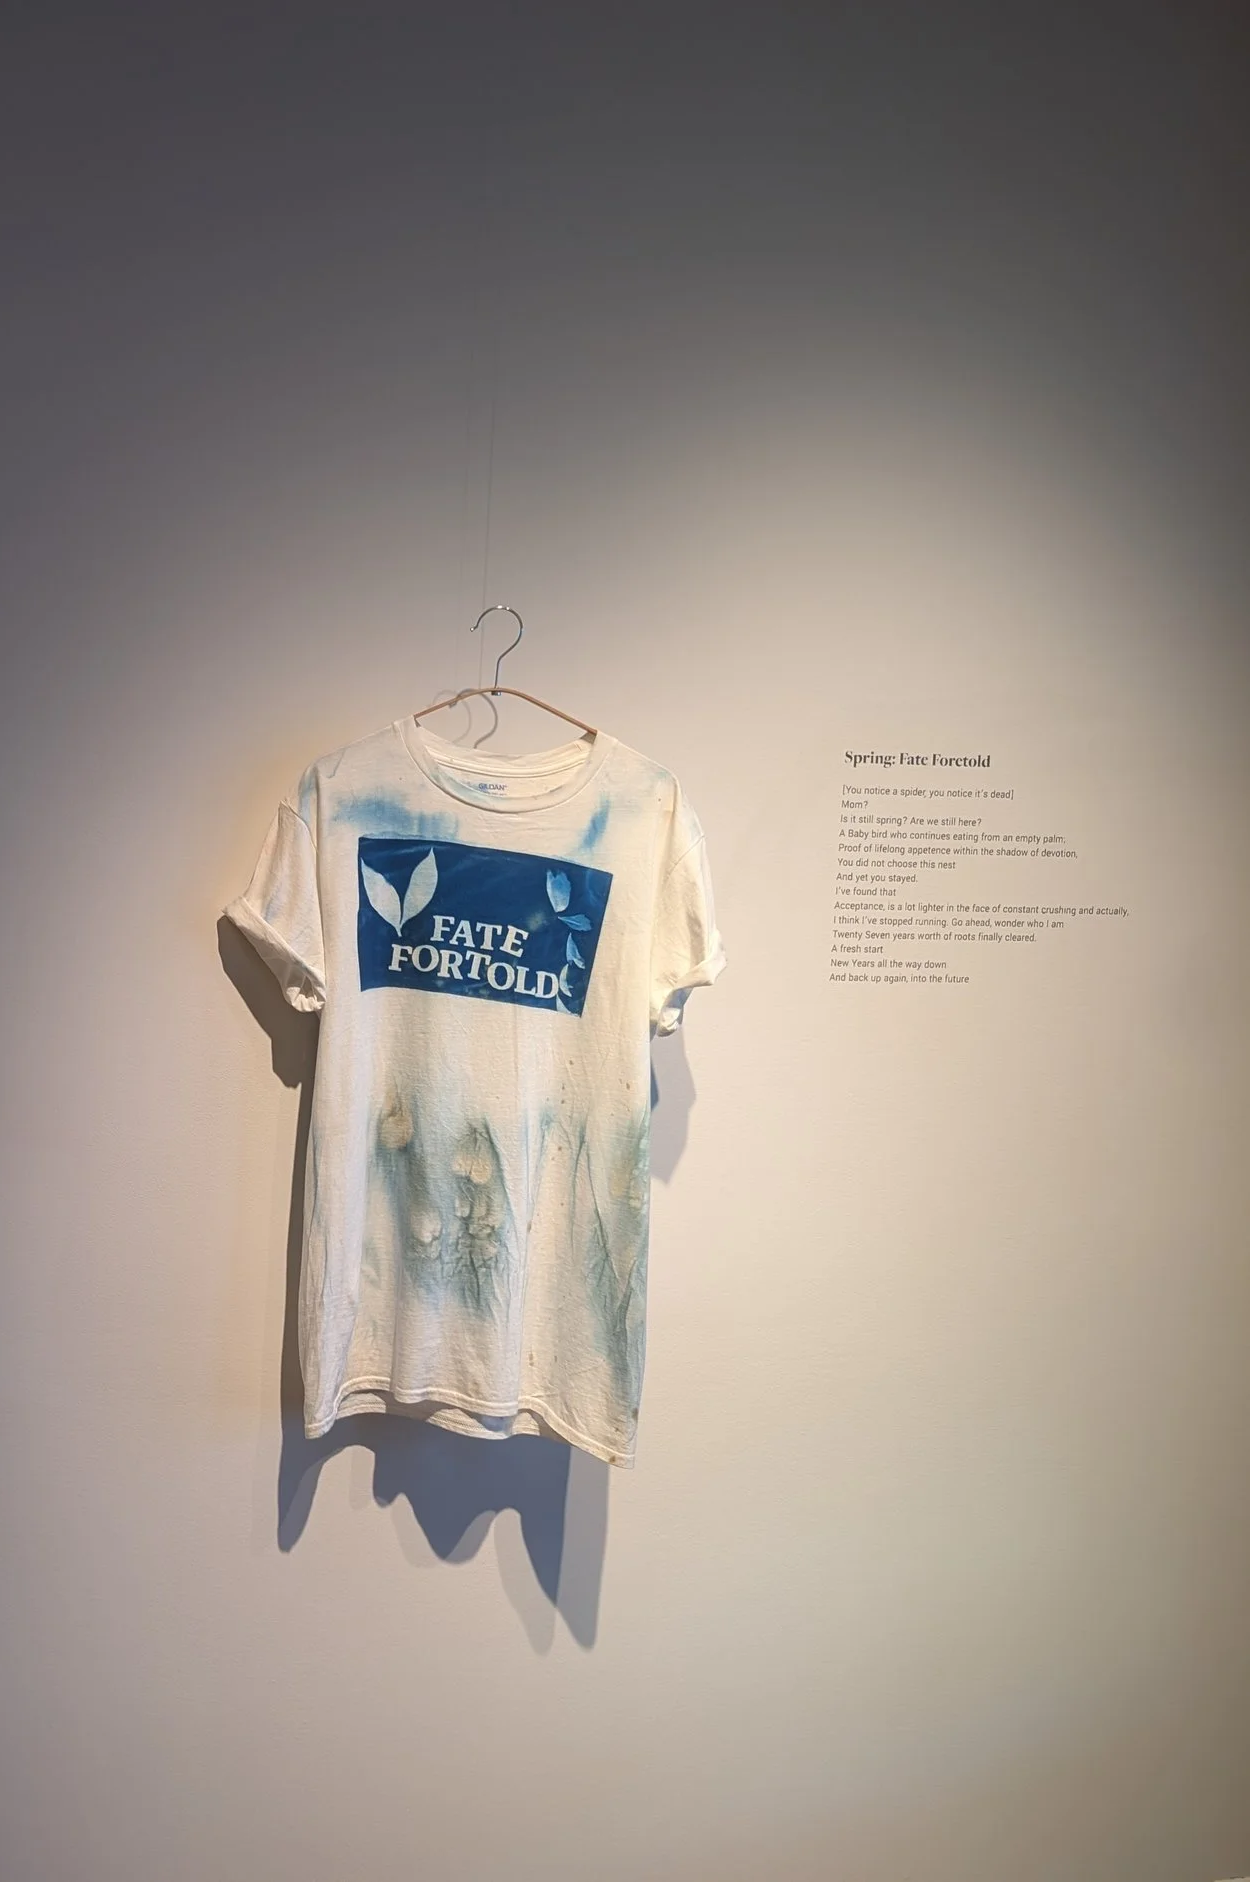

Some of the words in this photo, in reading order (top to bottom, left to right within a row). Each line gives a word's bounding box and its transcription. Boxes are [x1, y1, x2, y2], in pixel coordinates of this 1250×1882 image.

[844, 751, 896, 769] Spring:
[899, 752, 929, 766] Fate
[932, 753, 991, 768] Foretold
[864, 787, 891, 796] notice
[900, 787, 927, 798] spider,
[929, 790, 945, 799] you
[946, 788, 973, 798] notice
[841, 800, 868, 809] Mom?
[840, 814, 848, 823] Is
[850, 814, 856, 823] it
[858, 814, 874, 824] still
[876, 816, 908, 827] spring?
[909, 816, 925, 825] Are
[941, 817, 956, 826] still
[958, 817, 982, 827] here?
[848, 829, 869, 840] Baby
[871, 829, 888, 839] bird
[890, 830, 908, 839] who
[909, 831, 951, 841] continues
[952, 832, 979, 843] eating
[981, 832, 1000, 842] from
[1015, 835, 1041, 845] empty
[838, 843, 862, 852] Proof
[863, 843, 873, 853] of
[874, 844, 905, 856] lifelong
[907, 846, 951, 856] appetence
[953, 845, 978, 855] within
[981, 847, 994, 856] the
[996, 847, 1028, 857] shadow
[1030, 848, 1039, 857] of
[1041, 848, 1078, 859] devotion,
[837, 858, 854, 867] You
[855, 857, 869, 867] did
[871, 859, 885, 868] not
[887, 859, 918, 868] choose
[920, 859, 936, 869] this
[937, 861, 956, 869] nest
[836, 872, 853, 881] And
[855, 874, 868, 883] yet
[870, 874, 886, 884] you
[888, 874, 918, 885] stayed.
[853, 886, 878, 896] found
[879, 887, 896, 897] that
[833, 901, 885, 912] Acceptance,
[887, 903, 895, 911] is
[905, 902, 916, 911] lot
[918, 902, 944, 914] lighter
[946, 903, 954, 912] in
[956, 904, 970, 913] the
[972, 903, 990, 913] face
[991, 903, 1001, 913] of
[1002, 905, 1039, 914] constant
[1041, 905, 1077, 917] crushing
[1078, 906, 1094, 915] and
[1096, 906, 1129, 918] actually,
[838, 915, 860, 924] think
[879, 917, 913, 927] stopped
[915, 917, 948, 929] running.
[951, 917, 963, 927] Go
[965, 917, 992, 928] ahead,
[994, 919, 1025, 928] wonder
[1026, 919, 1044, 928] who
[430, 914, 529, 958] FATE
[832, 929, 863, 941] Twenty
[865, 930, 890, 939] Seven
[892, 933, 915, 942] years
[917, 931, 941, 940] worth
[943, 931, 952, 940] of
[954, 933, 976, 941] roots
[978, 932, 1003, 943] finally
[1004, 932, 1036, 942] cleared.
[840, 943, 862, 953] fresh
[864, 946, 883, 954] start
[388, 943, 560, 999] FORTOLD
[830, 959, 849, 967] New
[851, 959, 875, 968] Years
[877, 959, 888, 968] all
[889, 959, 903, 968] the
[905, 961, 922, 971] way
[924, 960, 947, 969] down
[829, 973, 846, 982] And
[848, 972, 868, 982] back
[871, 975, 882, 984] up
[883, 975, 908, 985] again,
[910, 973, 927, 983] into
[929, 974, 943, 983] the
[945, 974, 970, 983] future
